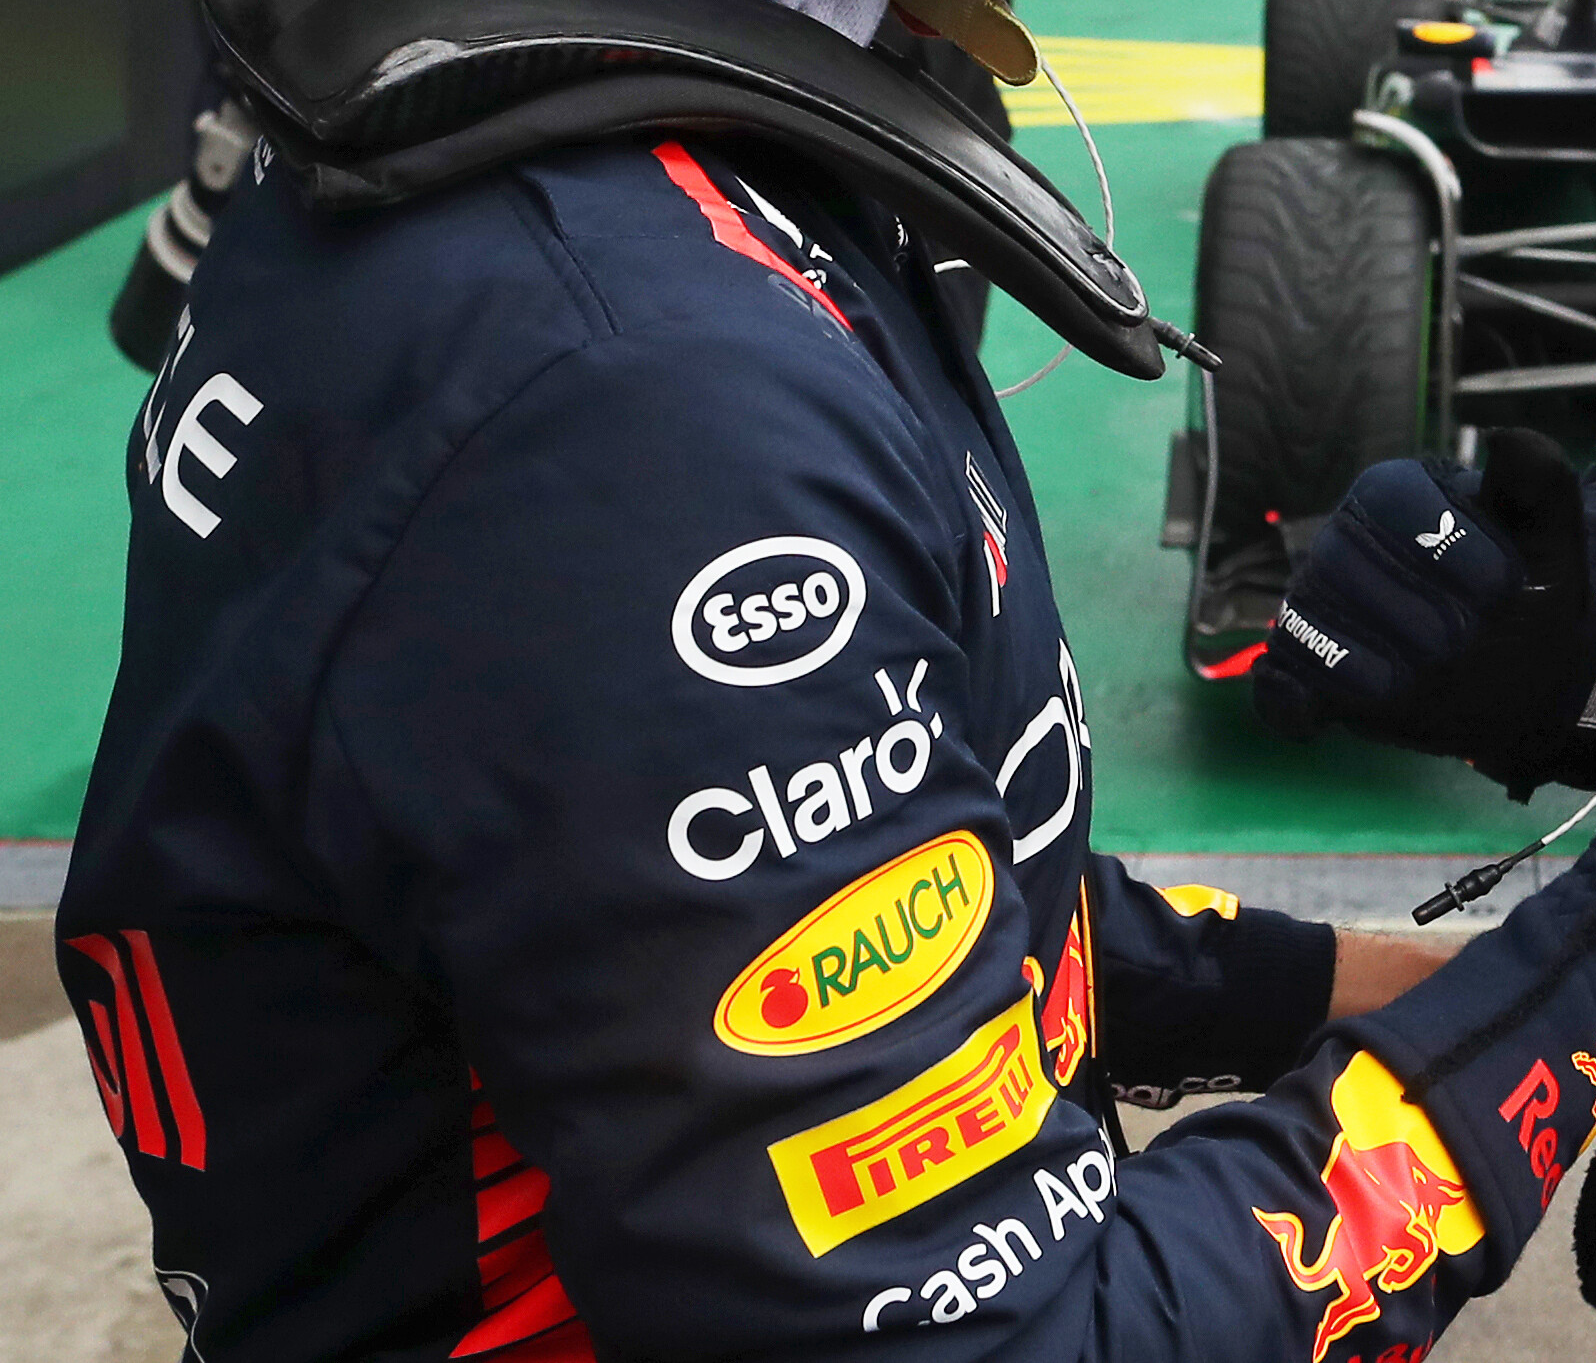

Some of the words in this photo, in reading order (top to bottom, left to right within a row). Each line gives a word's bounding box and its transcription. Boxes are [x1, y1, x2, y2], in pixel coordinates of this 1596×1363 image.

[667, 717, 935, 881] Claro
[813, 853, 969, 1008] RAUCH
[810, 1024, 1033, 1217] PIRELLI
[863, 1216, 1044, 1332] Cash
